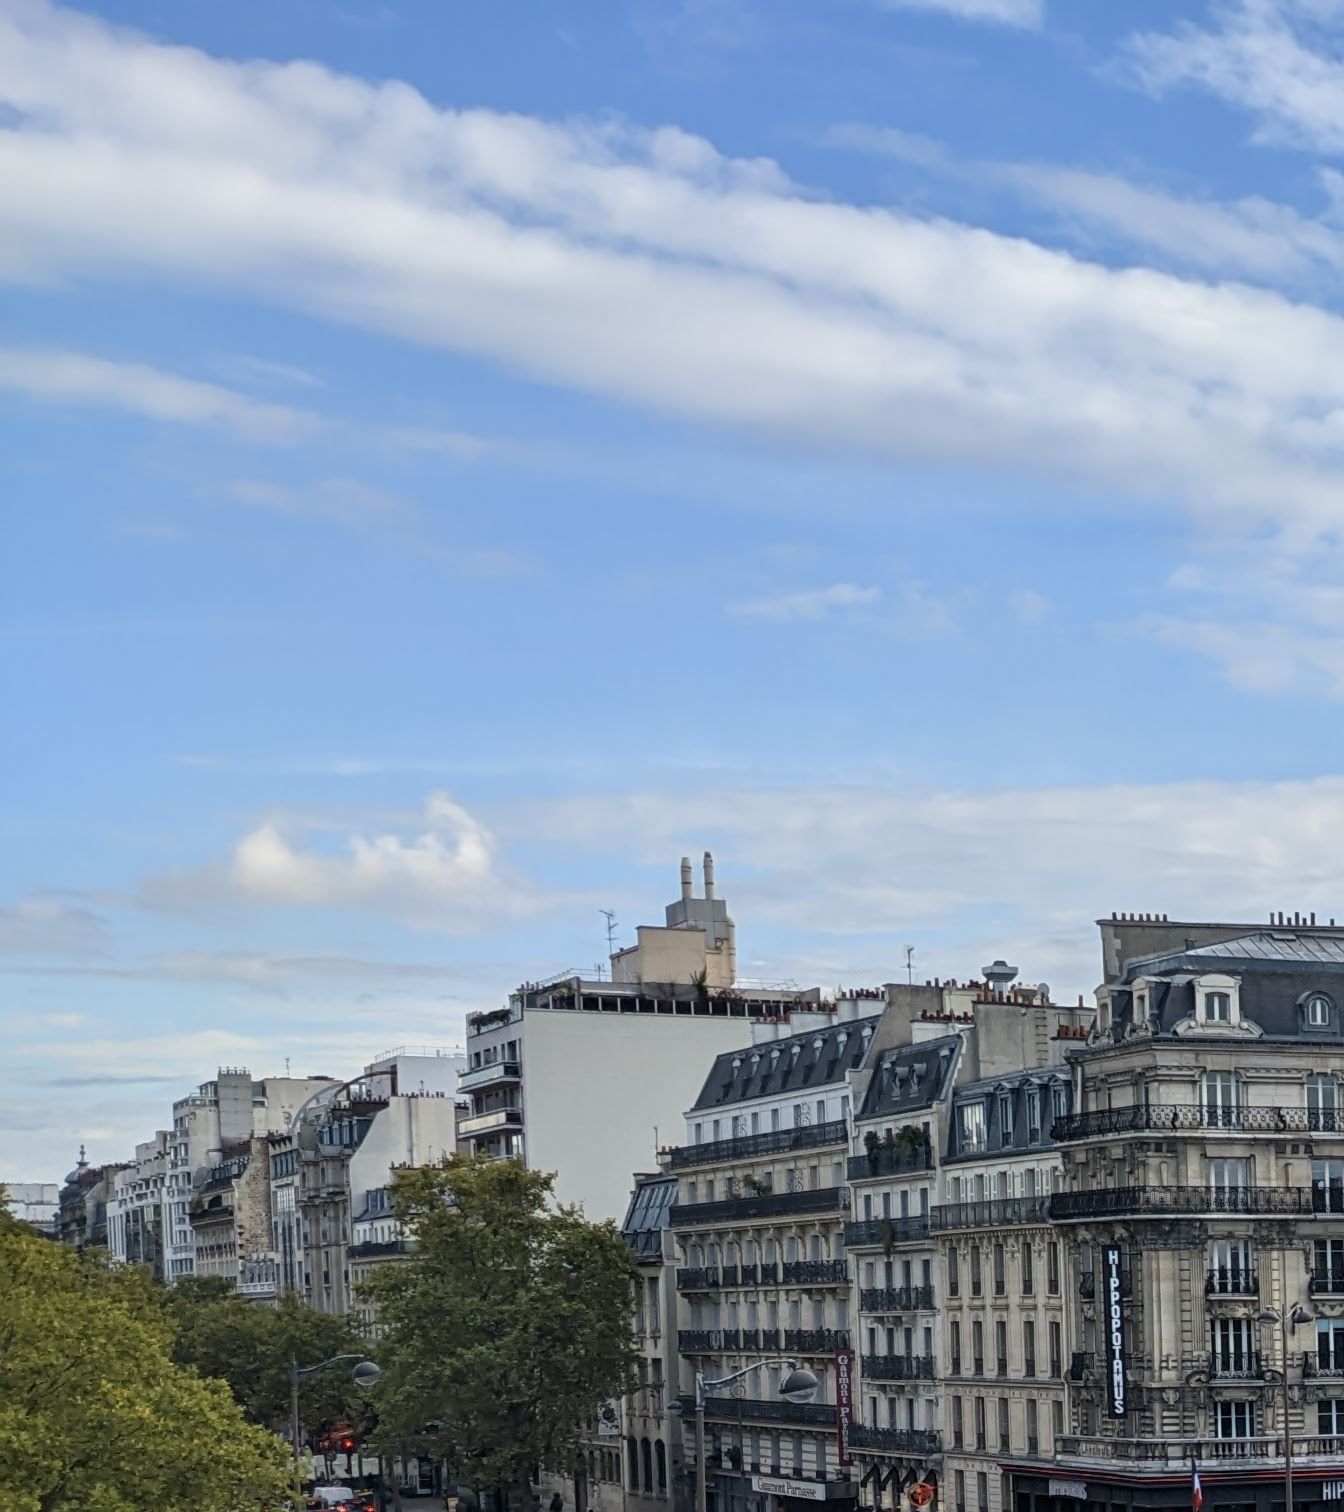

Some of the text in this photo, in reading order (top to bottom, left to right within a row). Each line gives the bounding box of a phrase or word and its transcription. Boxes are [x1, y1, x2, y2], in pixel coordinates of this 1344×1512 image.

[1108, 1250, 1125, 1415] HIPPOPOTAMUS
[837, 1354, 851, 1462] Gaumont Parnasse
